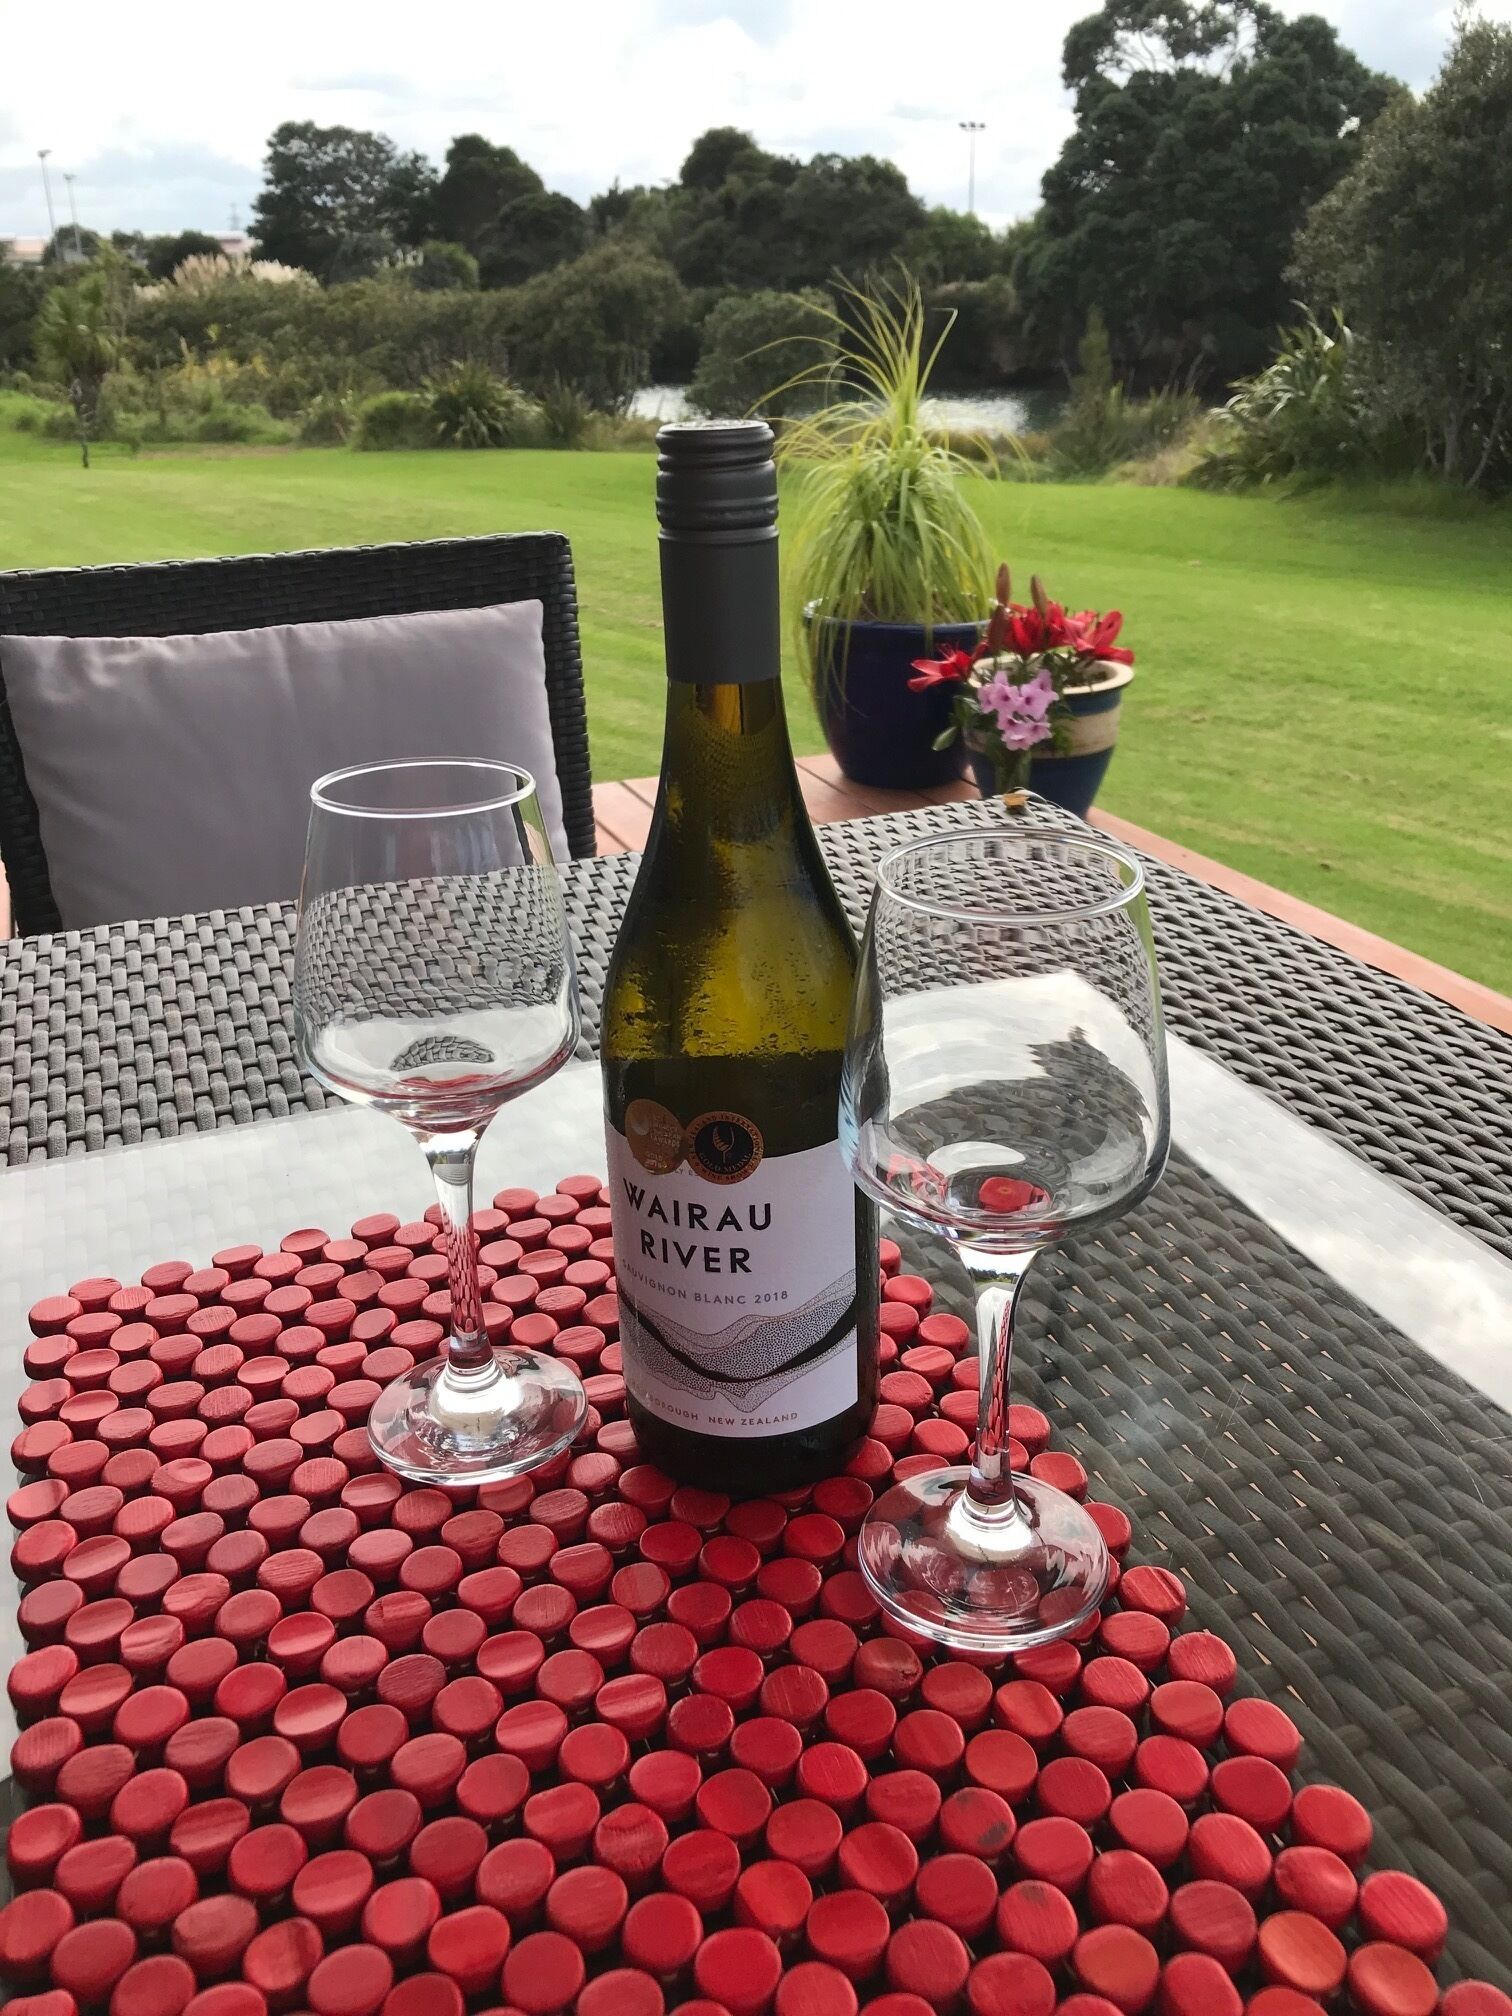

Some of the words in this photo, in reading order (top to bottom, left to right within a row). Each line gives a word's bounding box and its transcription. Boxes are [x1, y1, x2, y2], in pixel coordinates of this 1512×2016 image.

[622, 1178, 772, 1232] WAIRAU
[640, 1228, 753, 1274] RIVER
[622, 1259, 687, 1299] SAUVIGNON
[694, 1292, 747, 1305] BLANC
[754, 1290, 789, 1304] 2018
[708, 1415, 735, 1426] NEW
[740, 1412, 798, 1426] ZEALAND
